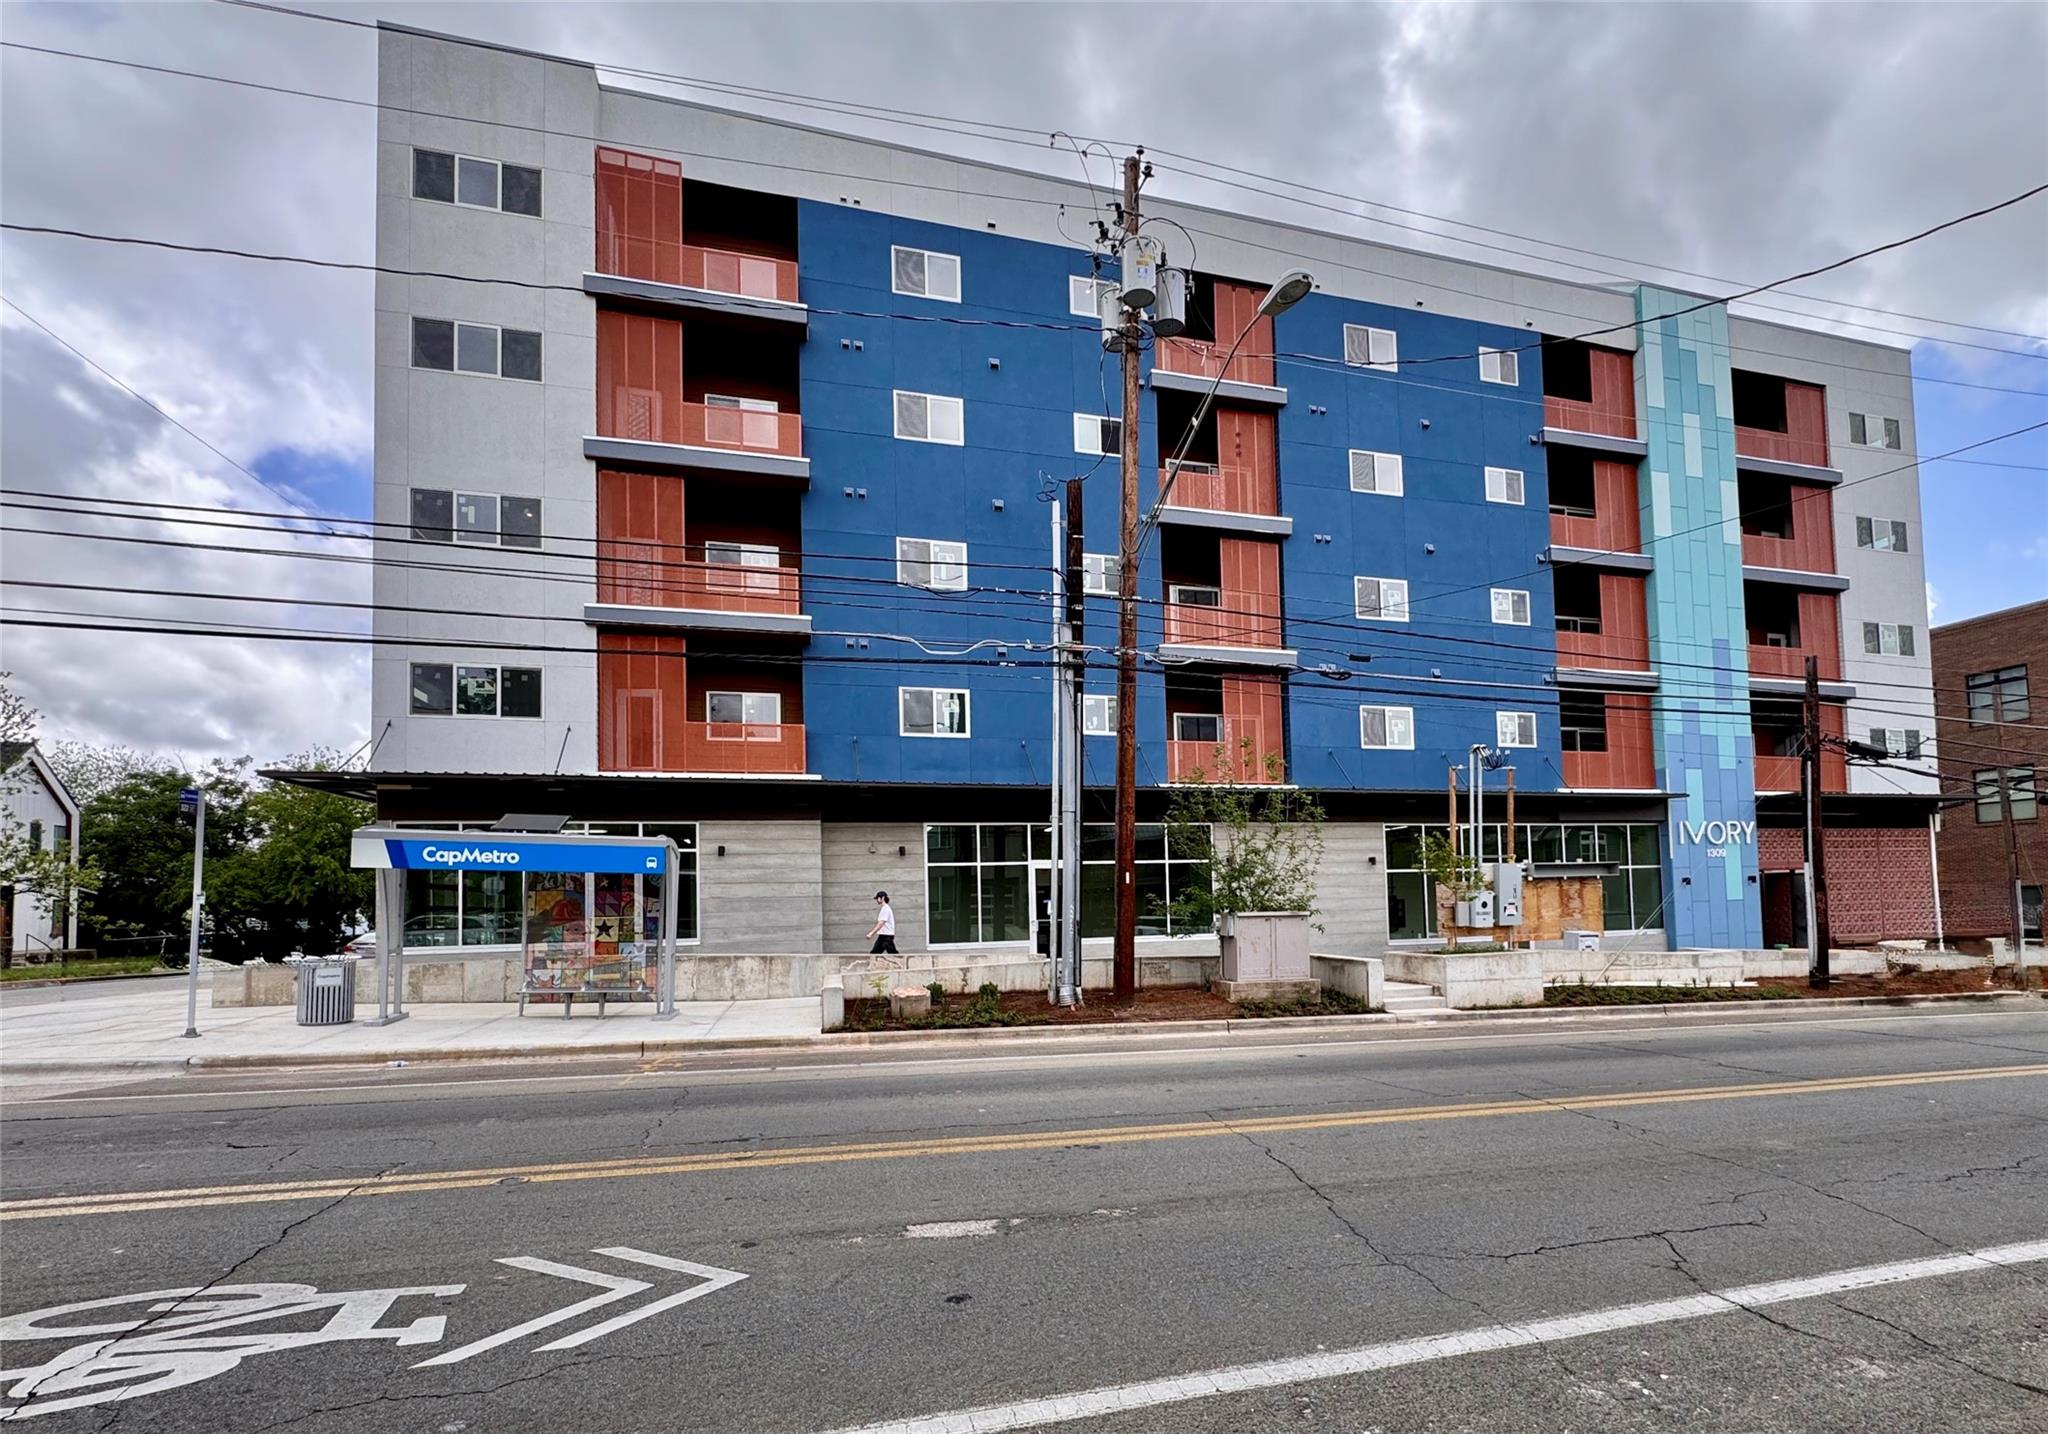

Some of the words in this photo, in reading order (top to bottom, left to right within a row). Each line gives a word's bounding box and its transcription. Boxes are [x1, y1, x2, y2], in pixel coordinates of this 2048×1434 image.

[1679, 821, 1754, 844] IVORY
[422, 846, 520, 866] CapMetro
[1707, 848, 1727, 857] 1309
